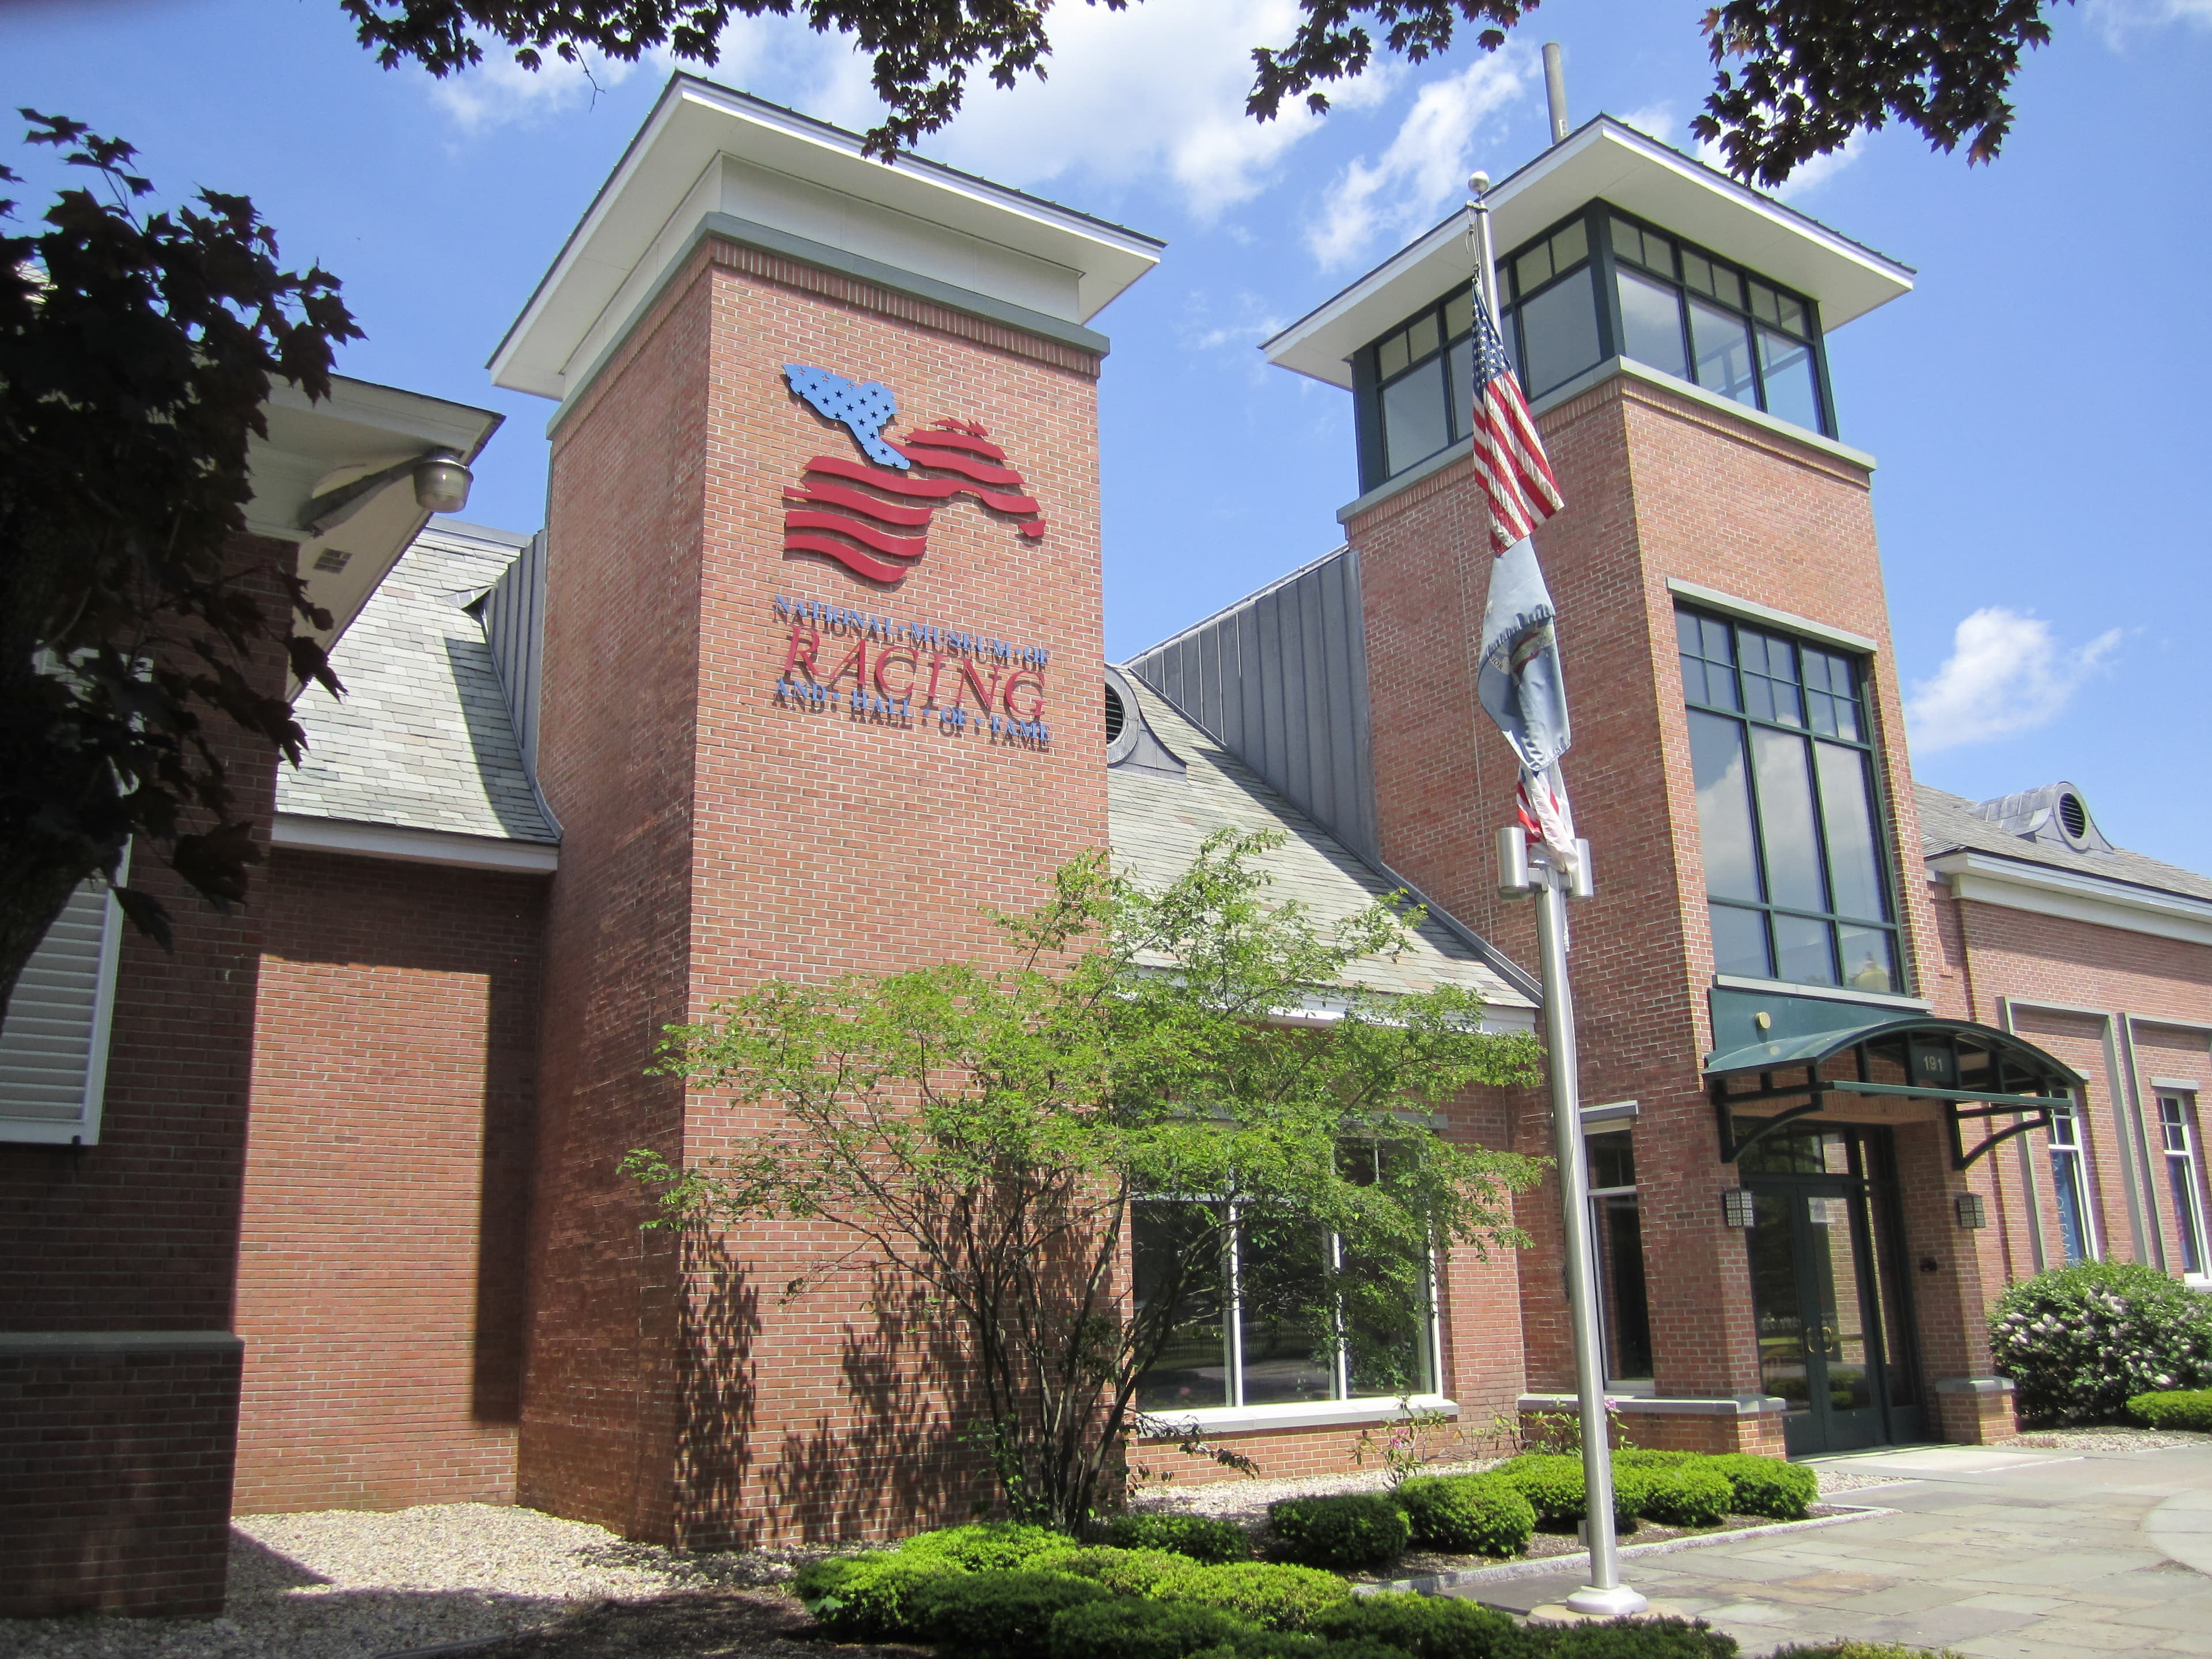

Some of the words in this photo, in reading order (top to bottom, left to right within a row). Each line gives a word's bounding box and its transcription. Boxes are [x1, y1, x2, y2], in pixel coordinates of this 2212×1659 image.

[774, 594, 897, 634] NATIONAL
[910, 622, 1011, 658] MUSEUM
[1023, 646, 1051, 664] OF
[778, 624, 1047, 718] RACING
[775, 679, 827, 702] AND
[851, 689, 915, 718] HALL
[940, 707, 968, 726] OF
[991, 715, 1052, 742] FAME
[1923, 1055, 1943, 1072] 191
